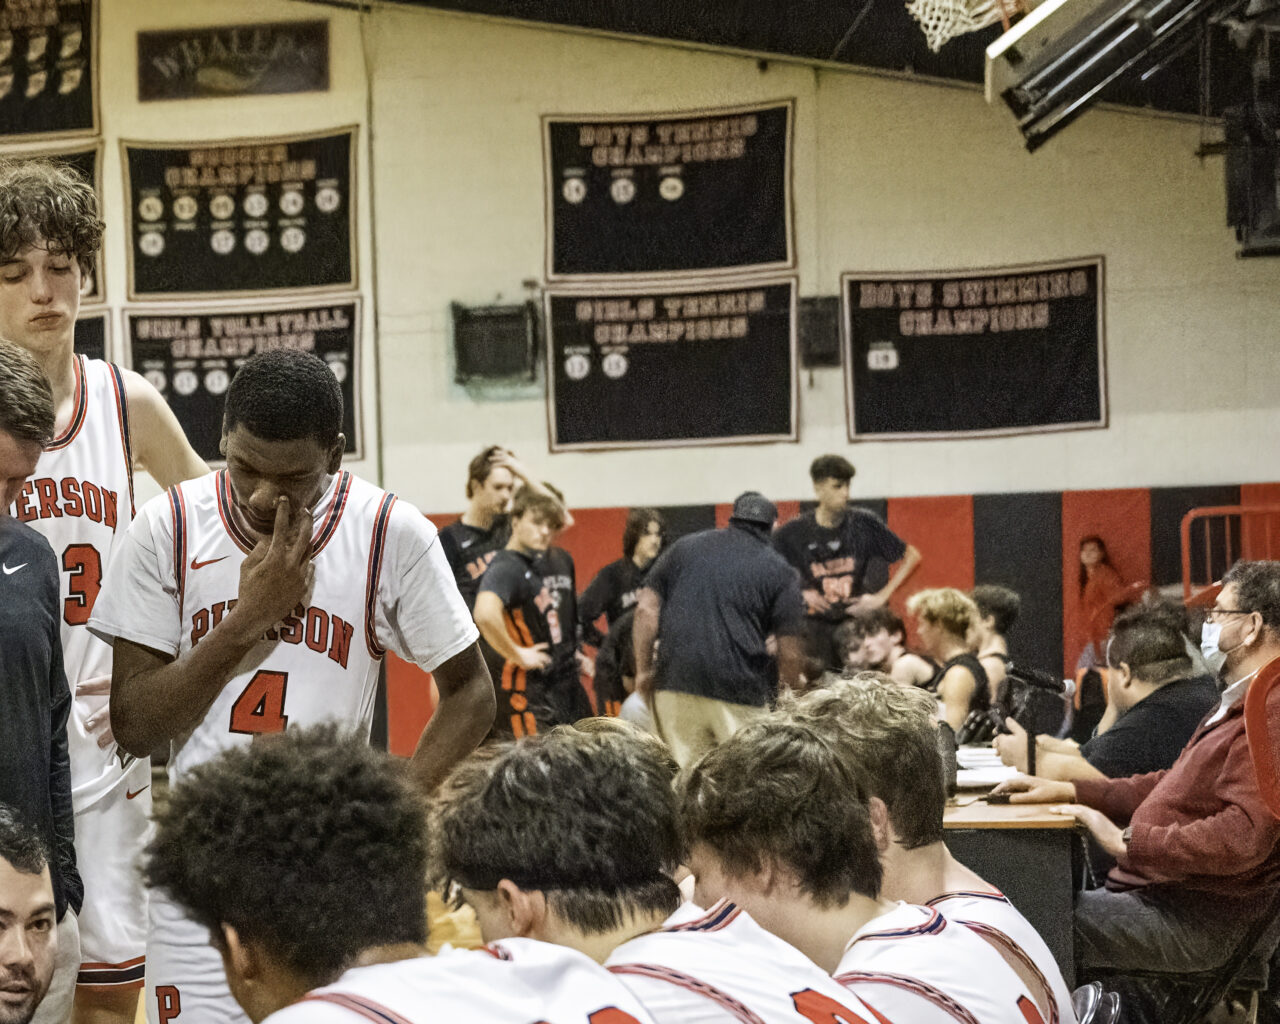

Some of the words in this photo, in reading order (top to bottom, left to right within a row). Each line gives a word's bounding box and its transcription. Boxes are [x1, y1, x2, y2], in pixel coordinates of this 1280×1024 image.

[859, 281, 933, 308] BOYS
[942, 270, 1087, 307] SWIMMING
[594, 316, 749, 344] CHAMPIONS
[899, 302, 1049, 336] CHAMPIONS
[10, 477, 117, 534] ERSON
[191, 599, 354, 670] PISON
[229, 670, 288, 734] 4
